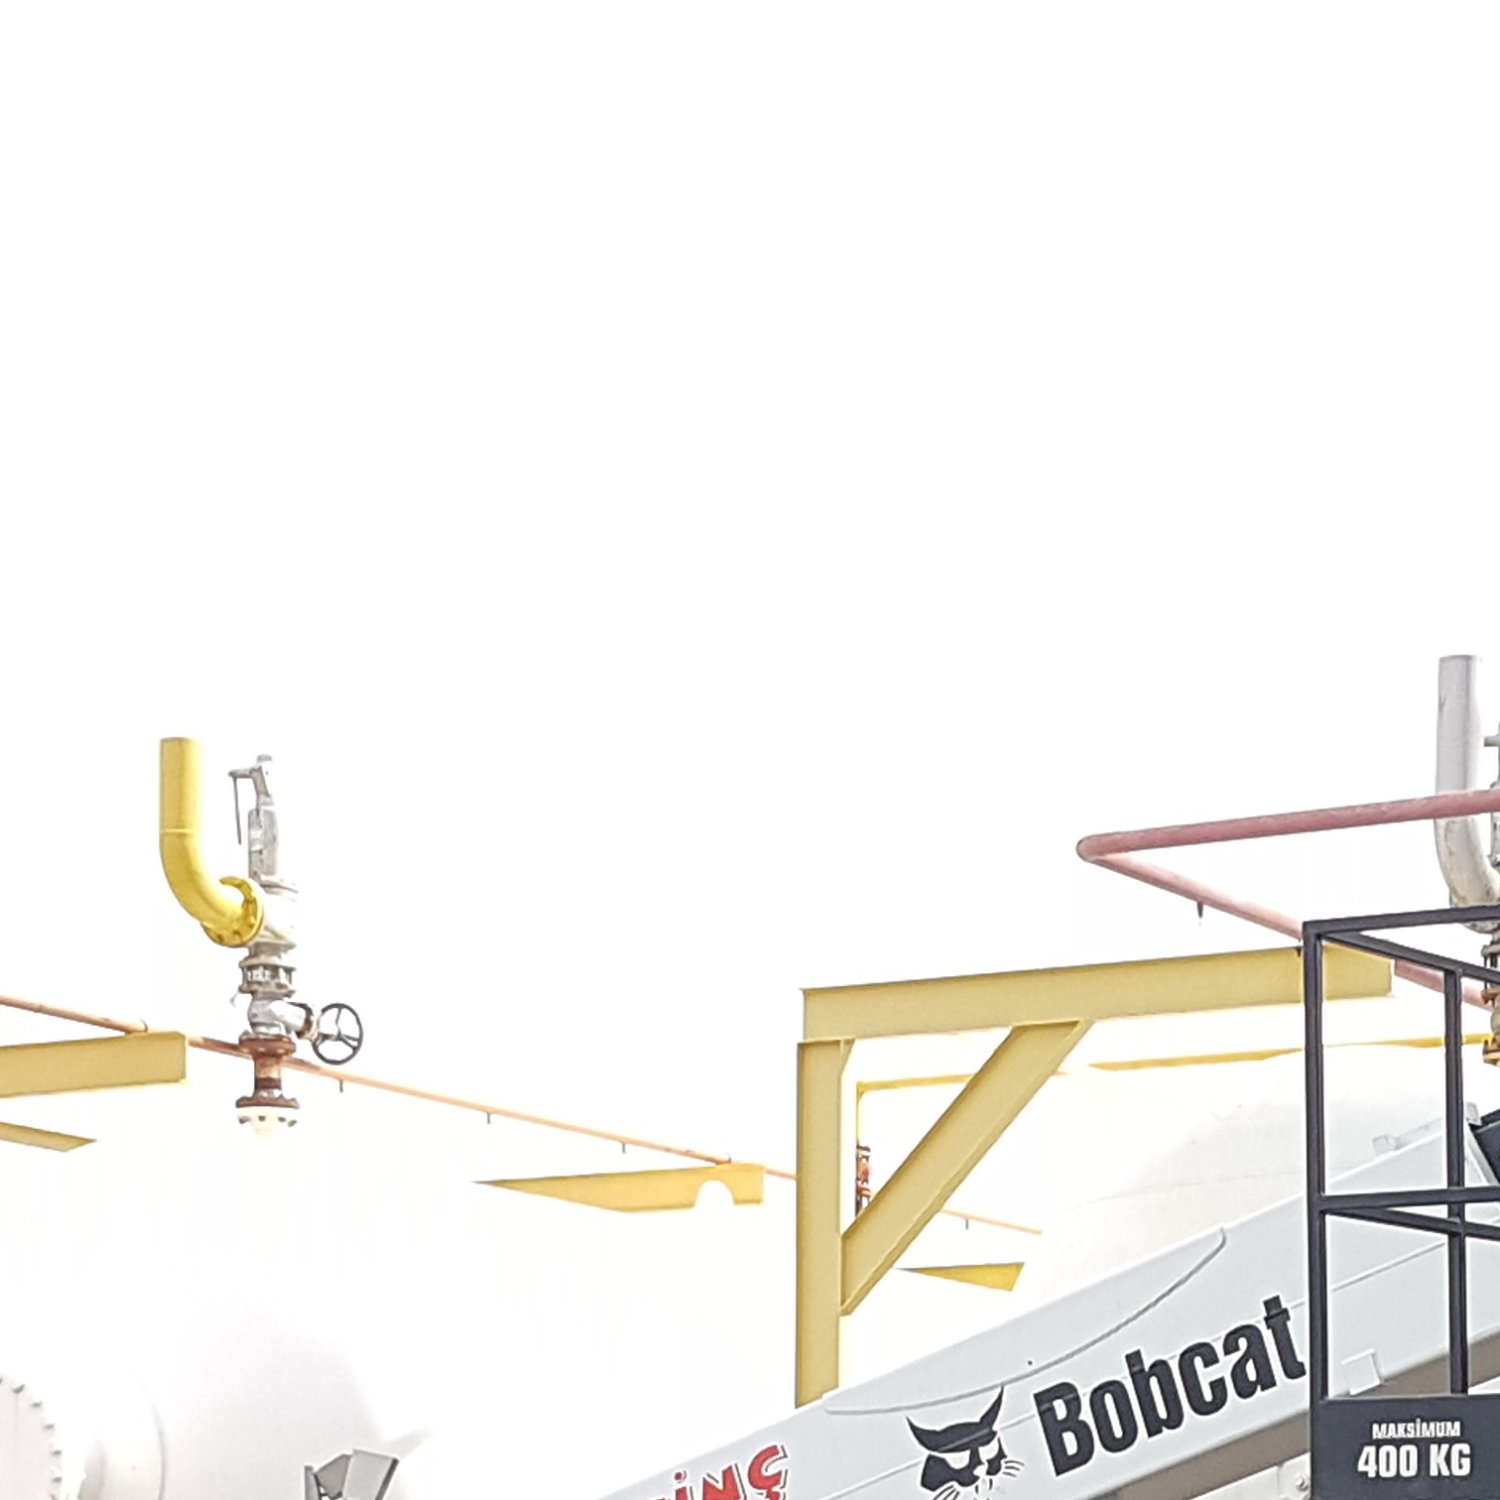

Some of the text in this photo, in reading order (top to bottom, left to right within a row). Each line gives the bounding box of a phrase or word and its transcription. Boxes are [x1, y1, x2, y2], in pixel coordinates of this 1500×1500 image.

[1033, 1295, 1306, 1477] Bobcat
[1372, 1418, 1461, 1440] MAKSİMUM
[1357, 1443, 1471, 1478] 400 KG
